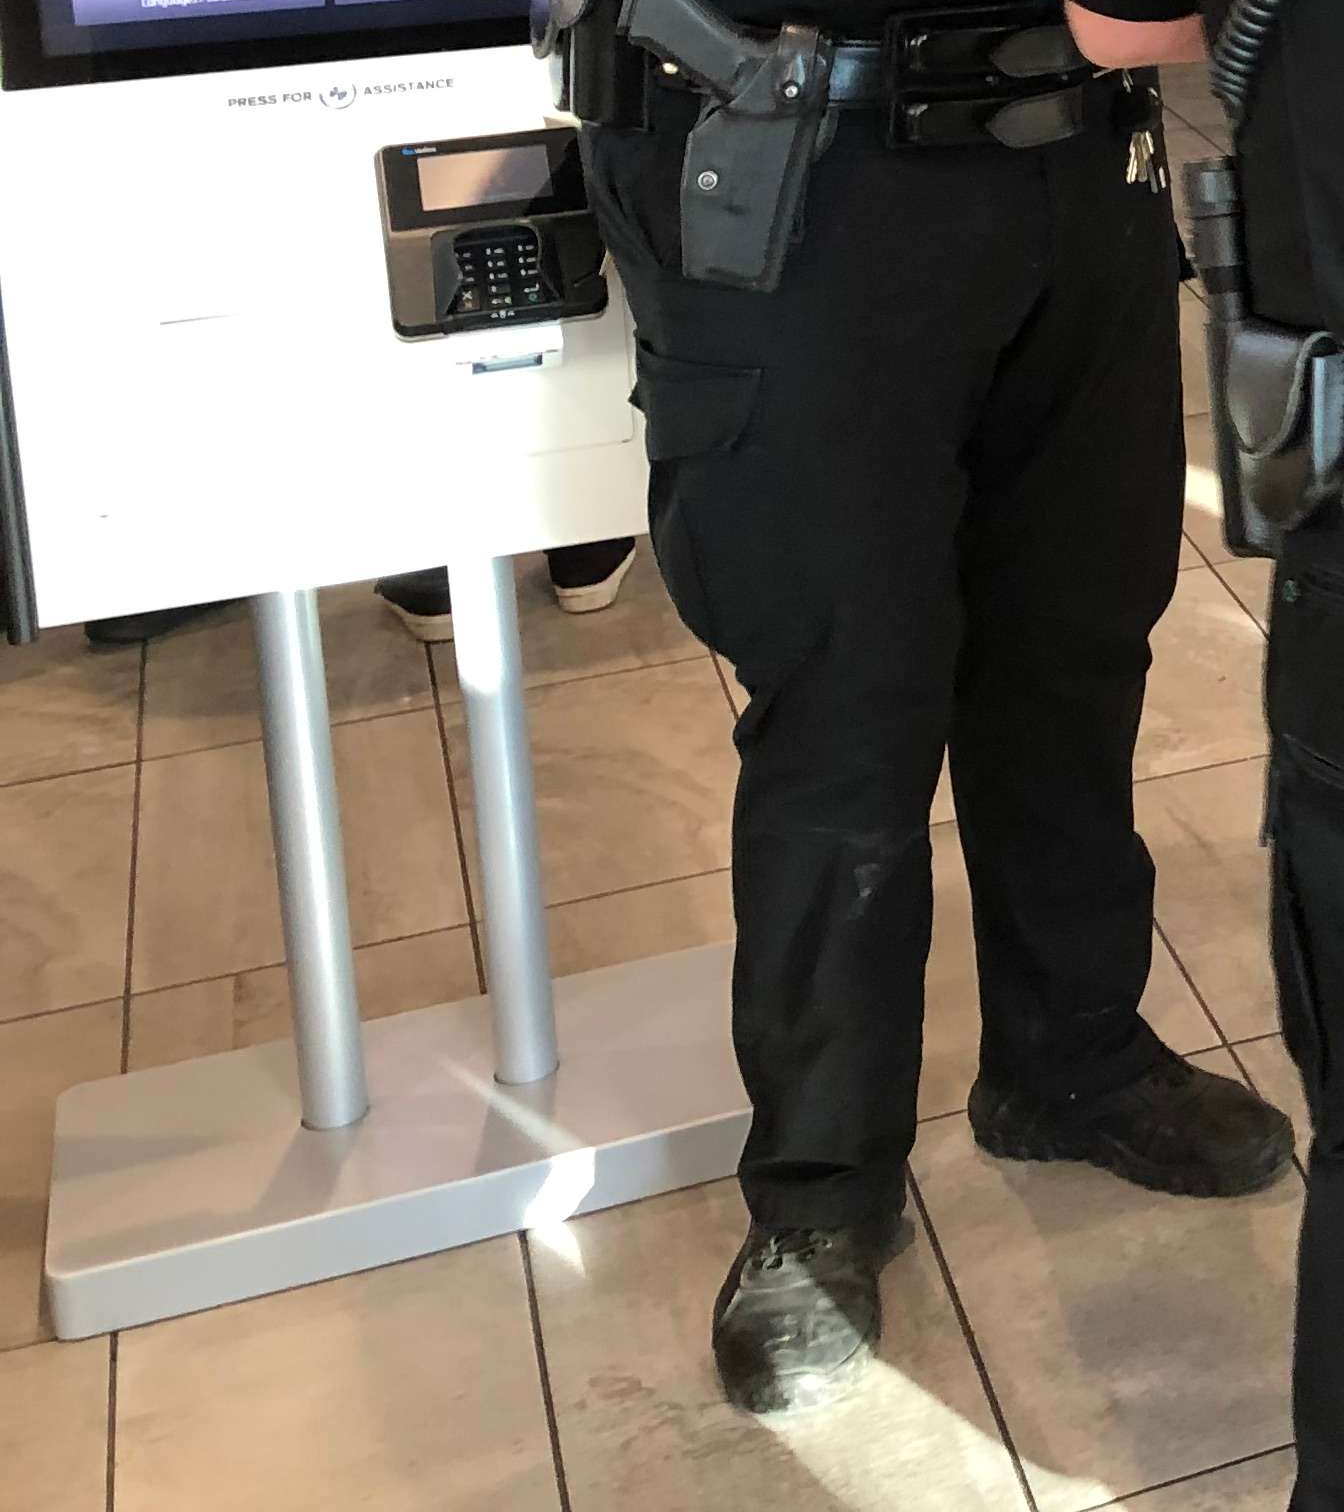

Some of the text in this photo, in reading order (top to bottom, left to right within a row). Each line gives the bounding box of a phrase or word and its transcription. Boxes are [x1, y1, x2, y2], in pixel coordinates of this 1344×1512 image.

[228, 78, 455, 108] PRESS FOR ASSISTANCE
